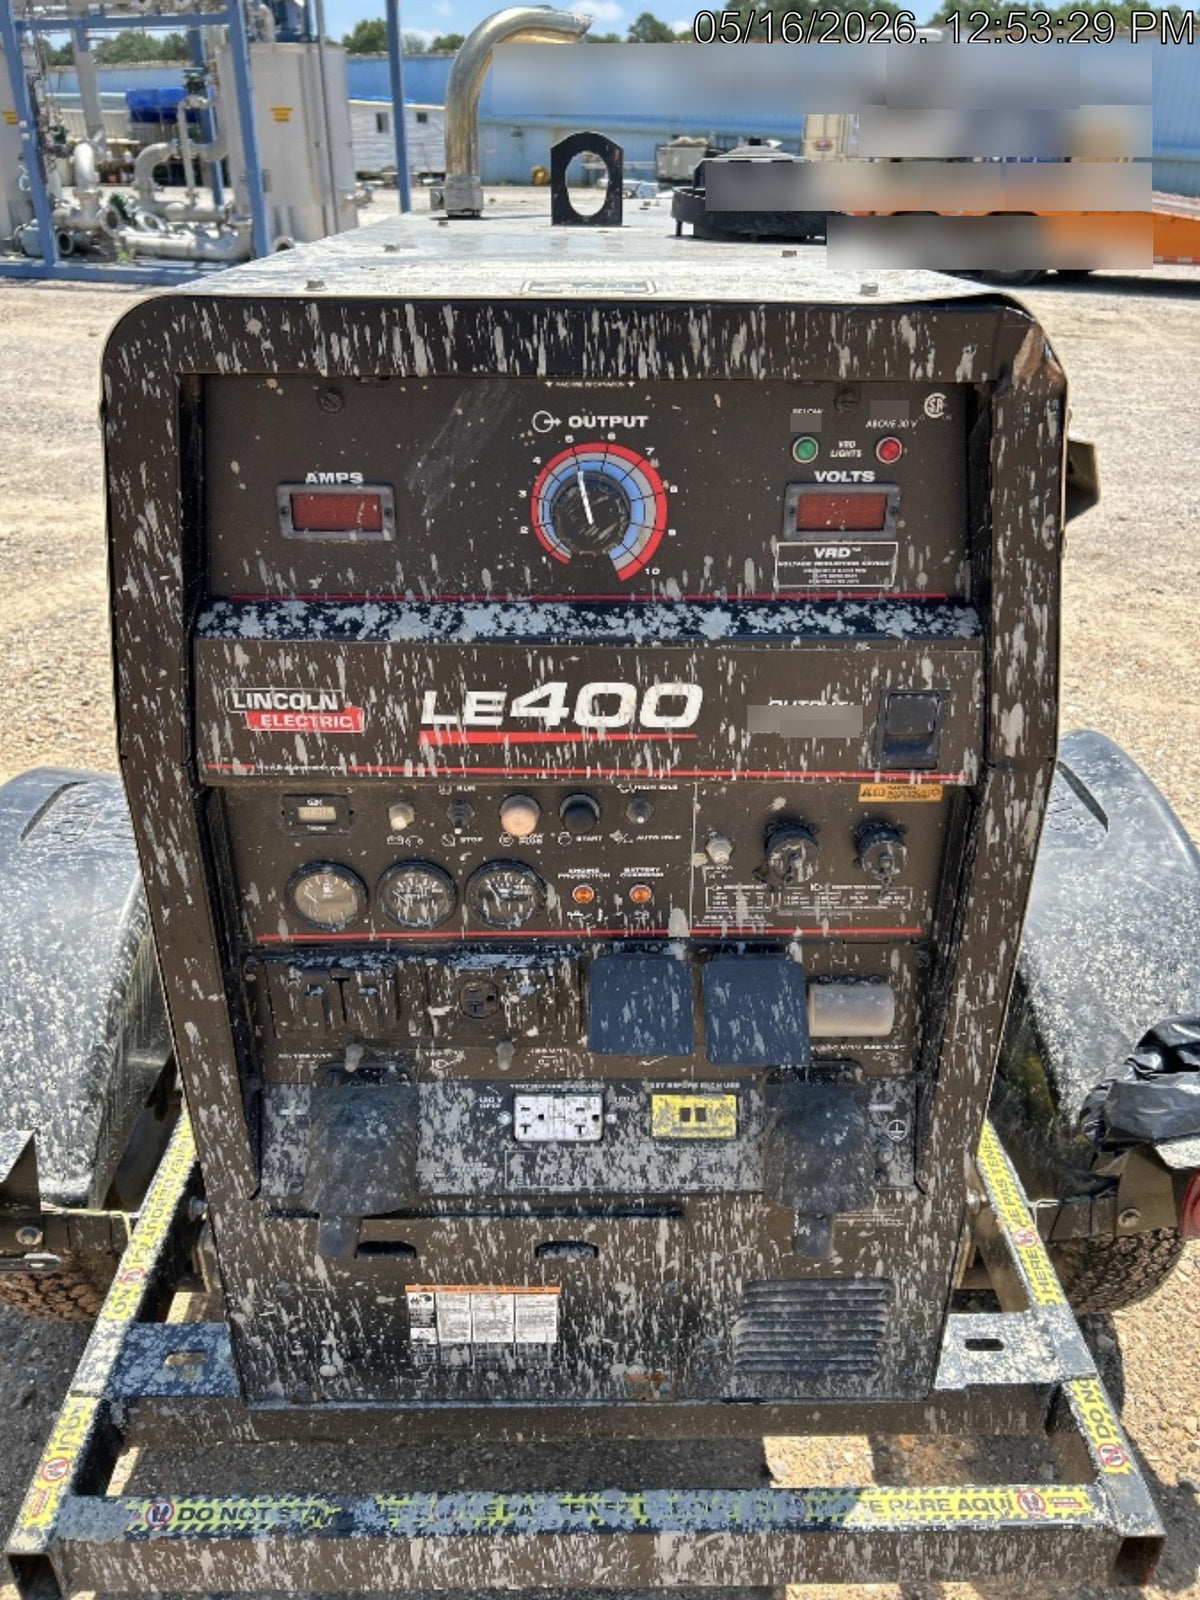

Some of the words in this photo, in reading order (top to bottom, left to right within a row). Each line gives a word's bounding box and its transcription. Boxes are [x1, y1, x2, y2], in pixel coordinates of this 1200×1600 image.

[568, 415, 648, 428] OUTPUT
[838, 440, 856, 448] VRD
[646, 447, 655, 456] 7
[533, 456, 541, 465] 4
[305, 472, 364, 485] AMPS
[814, 471, 875, 483] VOLTS
[644, 567, 660, 576] 10
[231, 692, 339, 711] LINCOLN
[420, 681, 703, 728] LE400
[260, 714, 352, 728] ELECTRIC
[997, 1178, 1016, 1206] PAS
[1027, 1248, 1053, 1294] HERE
[1088, 1407, 1111, 1440] DO
[889, 1498, 952, 1513] PARE
[177, 1506, 214, 1522] DO
[219, 1505, 272, 1522] NOT
